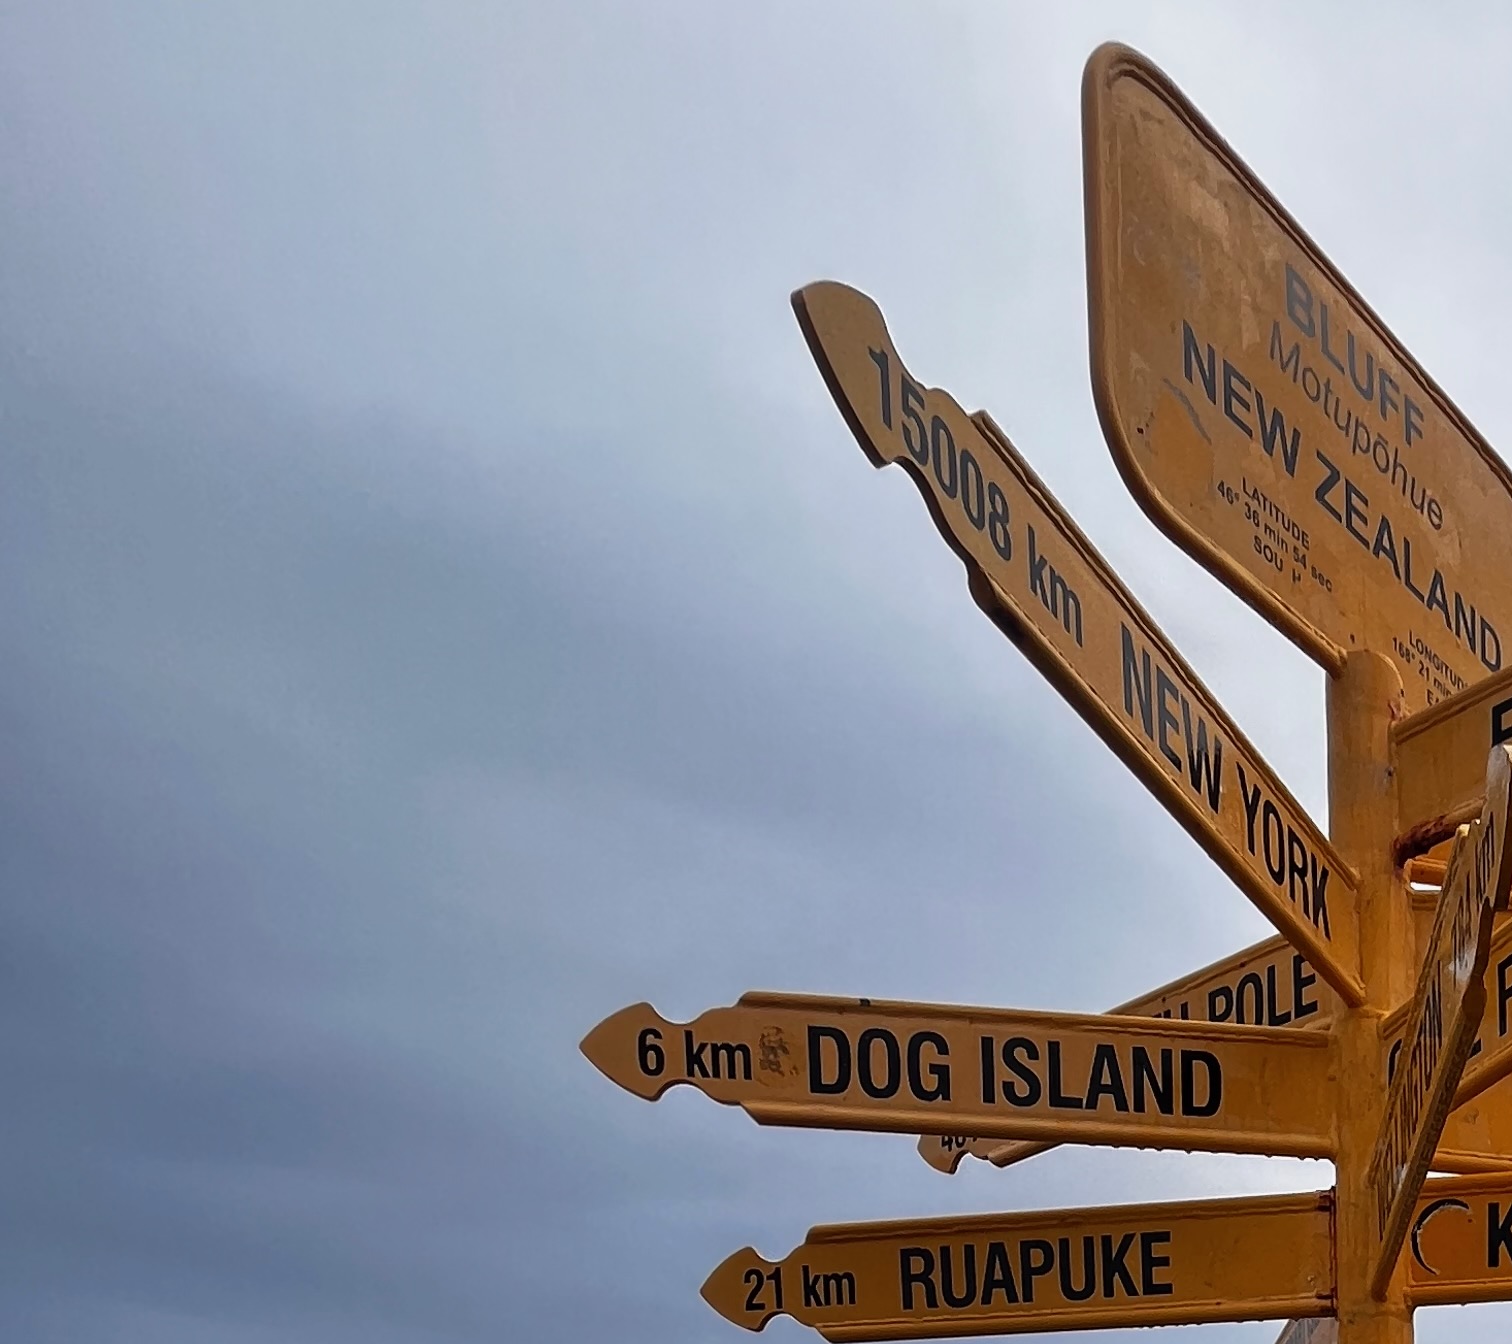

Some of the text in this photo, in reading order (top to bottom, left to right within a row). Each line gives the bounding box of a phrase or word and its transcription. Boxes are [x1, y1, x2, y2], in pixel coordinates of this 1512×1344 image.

[1286, 262, 1425, 447] BLUFF
[1183, 319, 1501, 672] NEW ZEALAND
[1242, 476, 1310, 551] LATITUDE
[1244, 501, 1260, 528] 36
[1264, 522, 1289, 554] min
[1292, 545, 1308, 570] 54
[1310, 564, 1332, 592] sec
[868, 345, 1332, 941] 15008 km NEW YORK
[1408, 629, 1468, 690] LONGITUD
[1418, 659, 1430, 681] 21
[636, 1024, 1224, 1118] 6 km DOG ISLAND
[743, 1229, 1175, 1313] 21 km RUAPUKE
